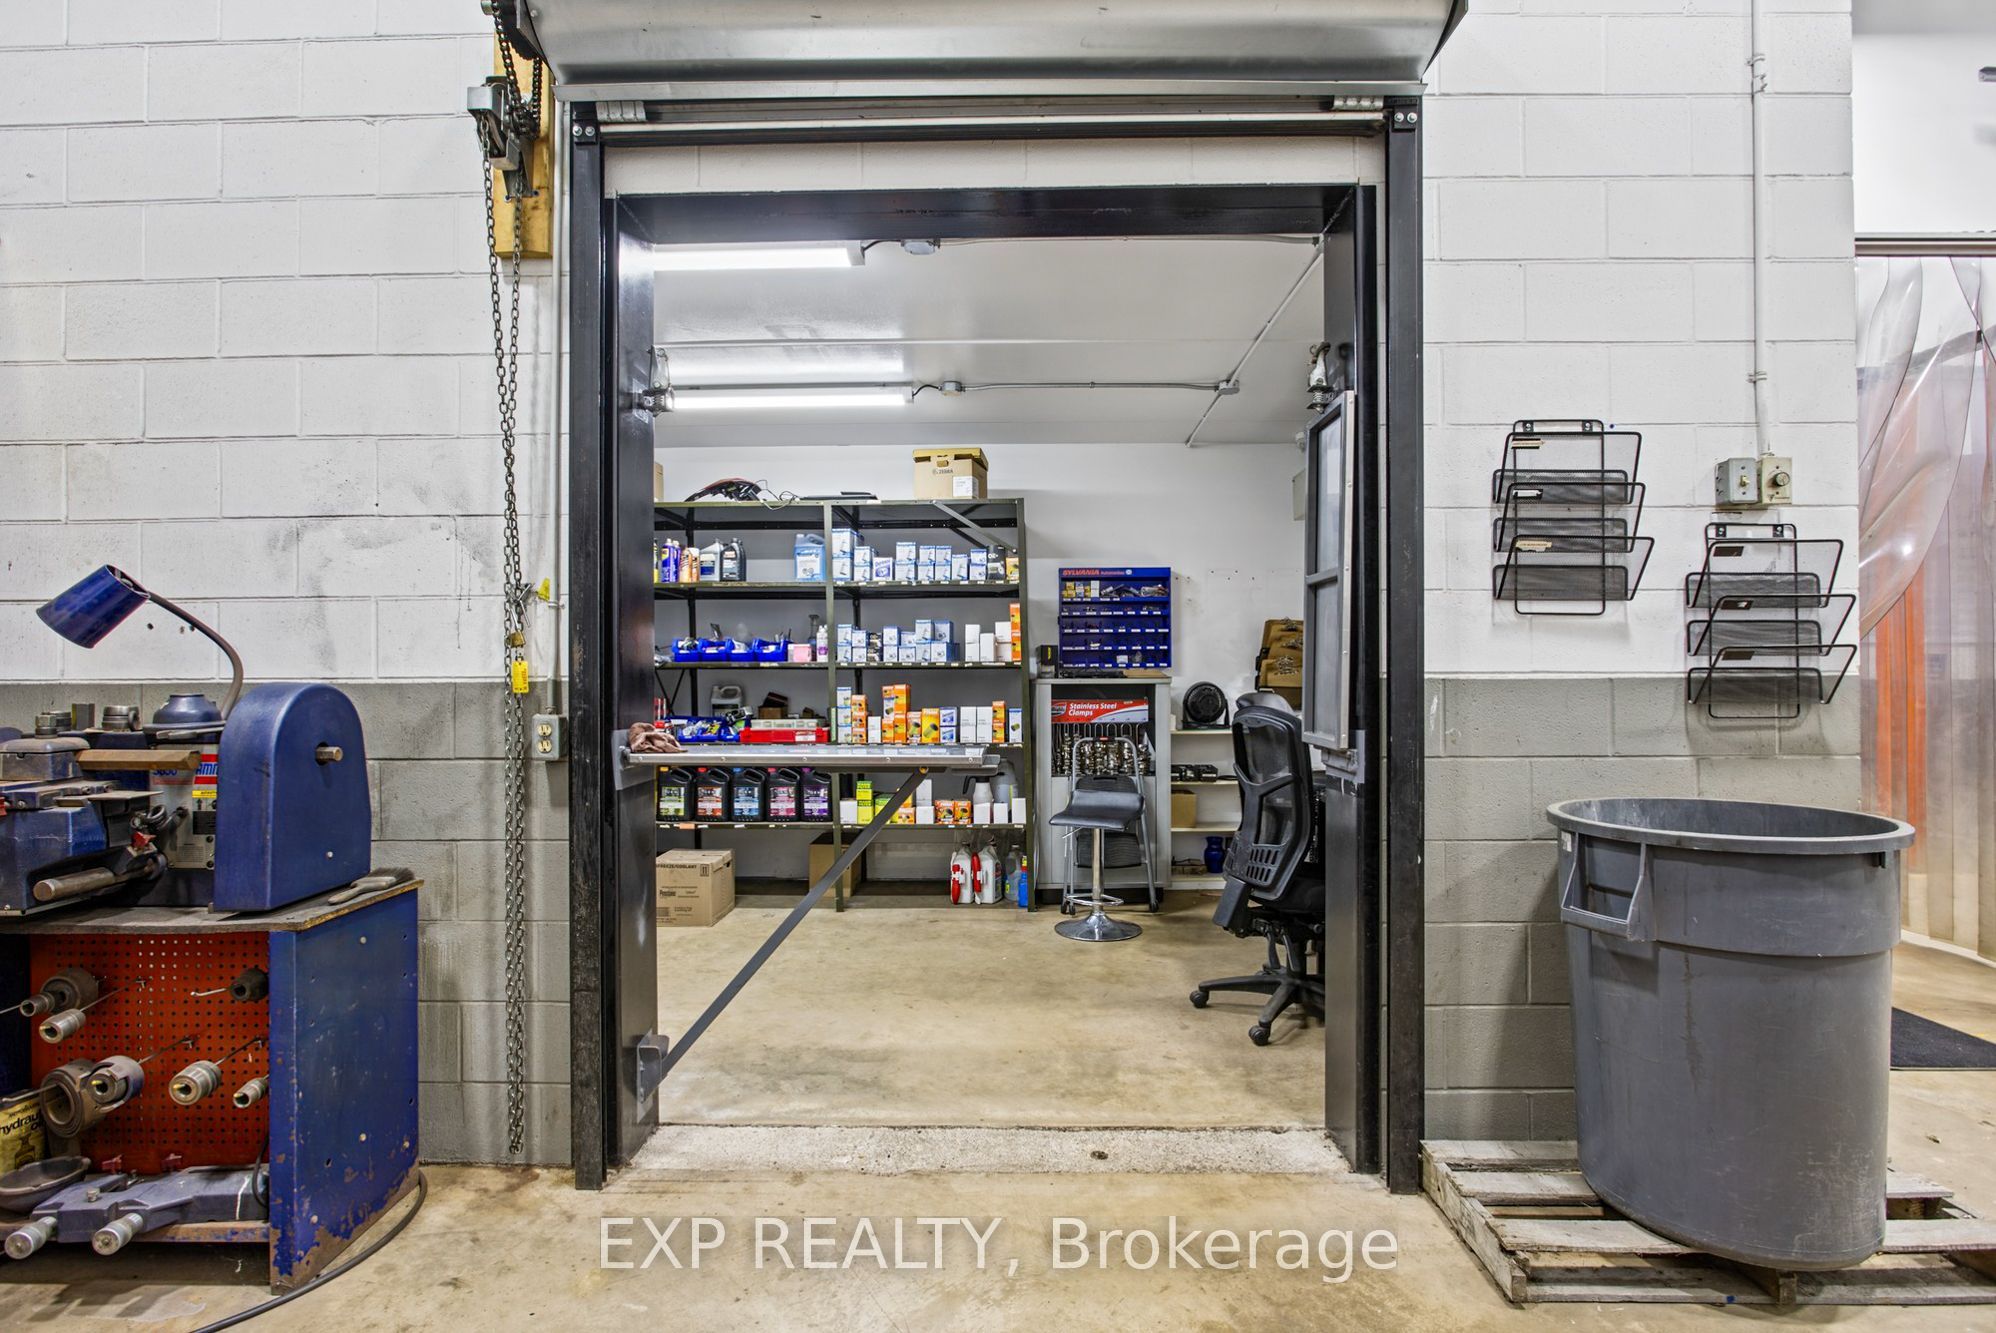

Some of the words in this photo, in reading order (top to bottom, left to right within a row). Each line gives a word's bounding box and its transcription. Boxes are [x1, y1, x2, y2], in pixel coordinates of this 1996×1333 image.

[1069, 702, 1099, 710] Stainless
[1100, 702, 1117, 710] Steel
[1068, 709, 1093, 718] Clamps
